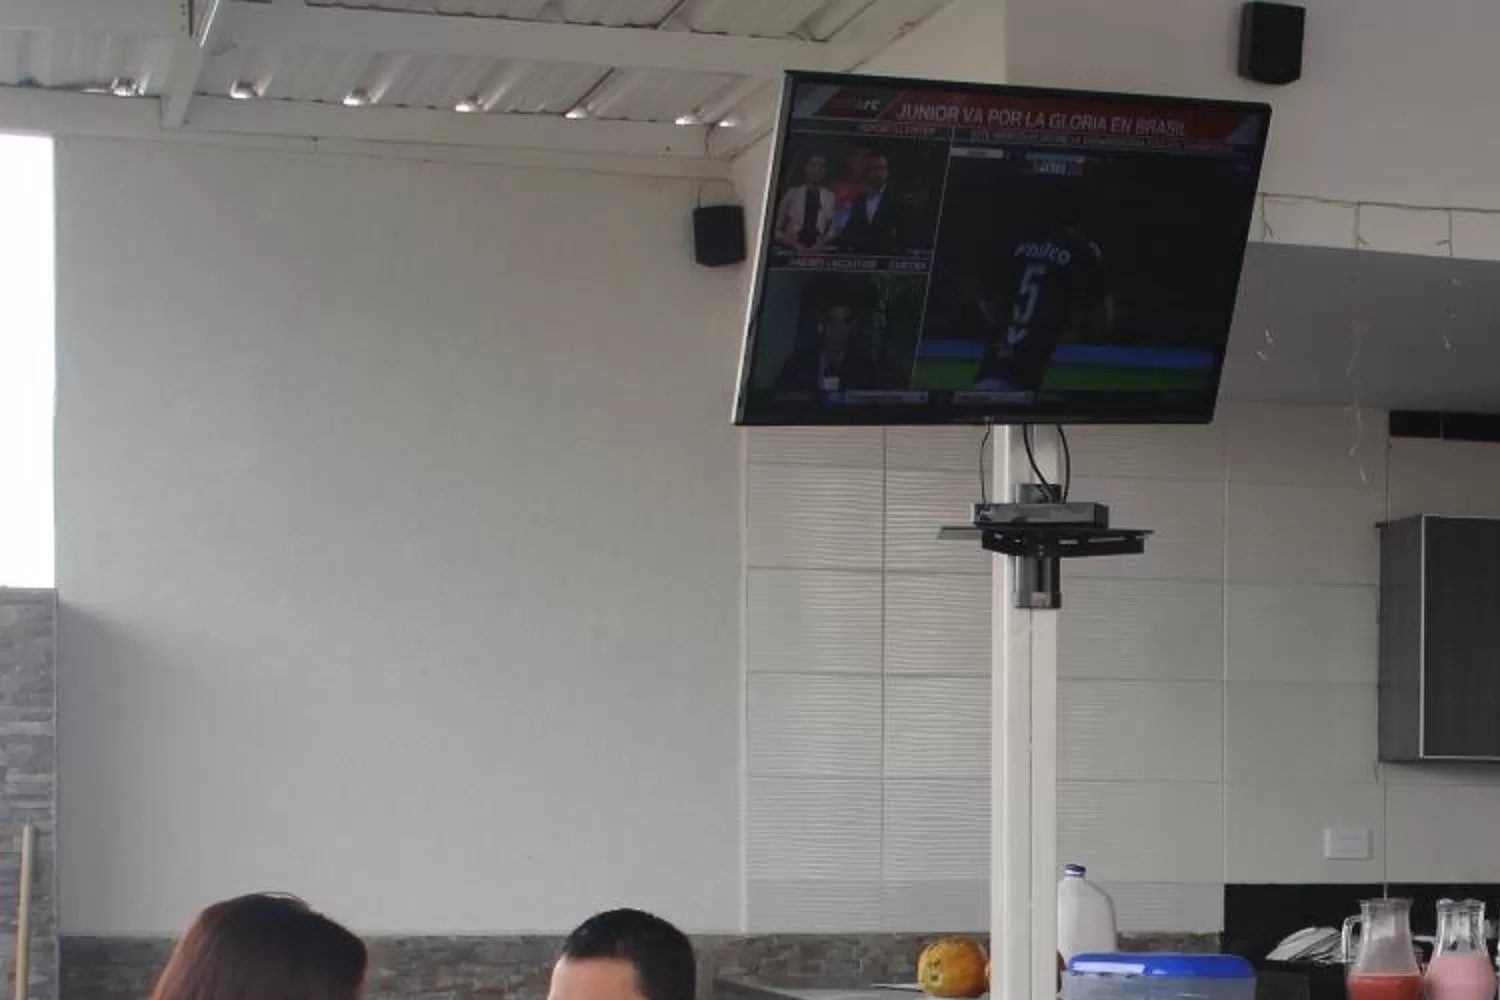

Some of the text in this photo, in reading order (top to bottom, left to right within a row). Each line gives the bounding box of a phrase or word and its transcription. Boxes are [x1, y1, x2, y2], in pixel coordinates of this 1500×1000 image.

[896, 104, 1185, 137] JUNIOR VA POR LA GLORIA EN BRASIL
[1012, 263, 1047, 324] 5
